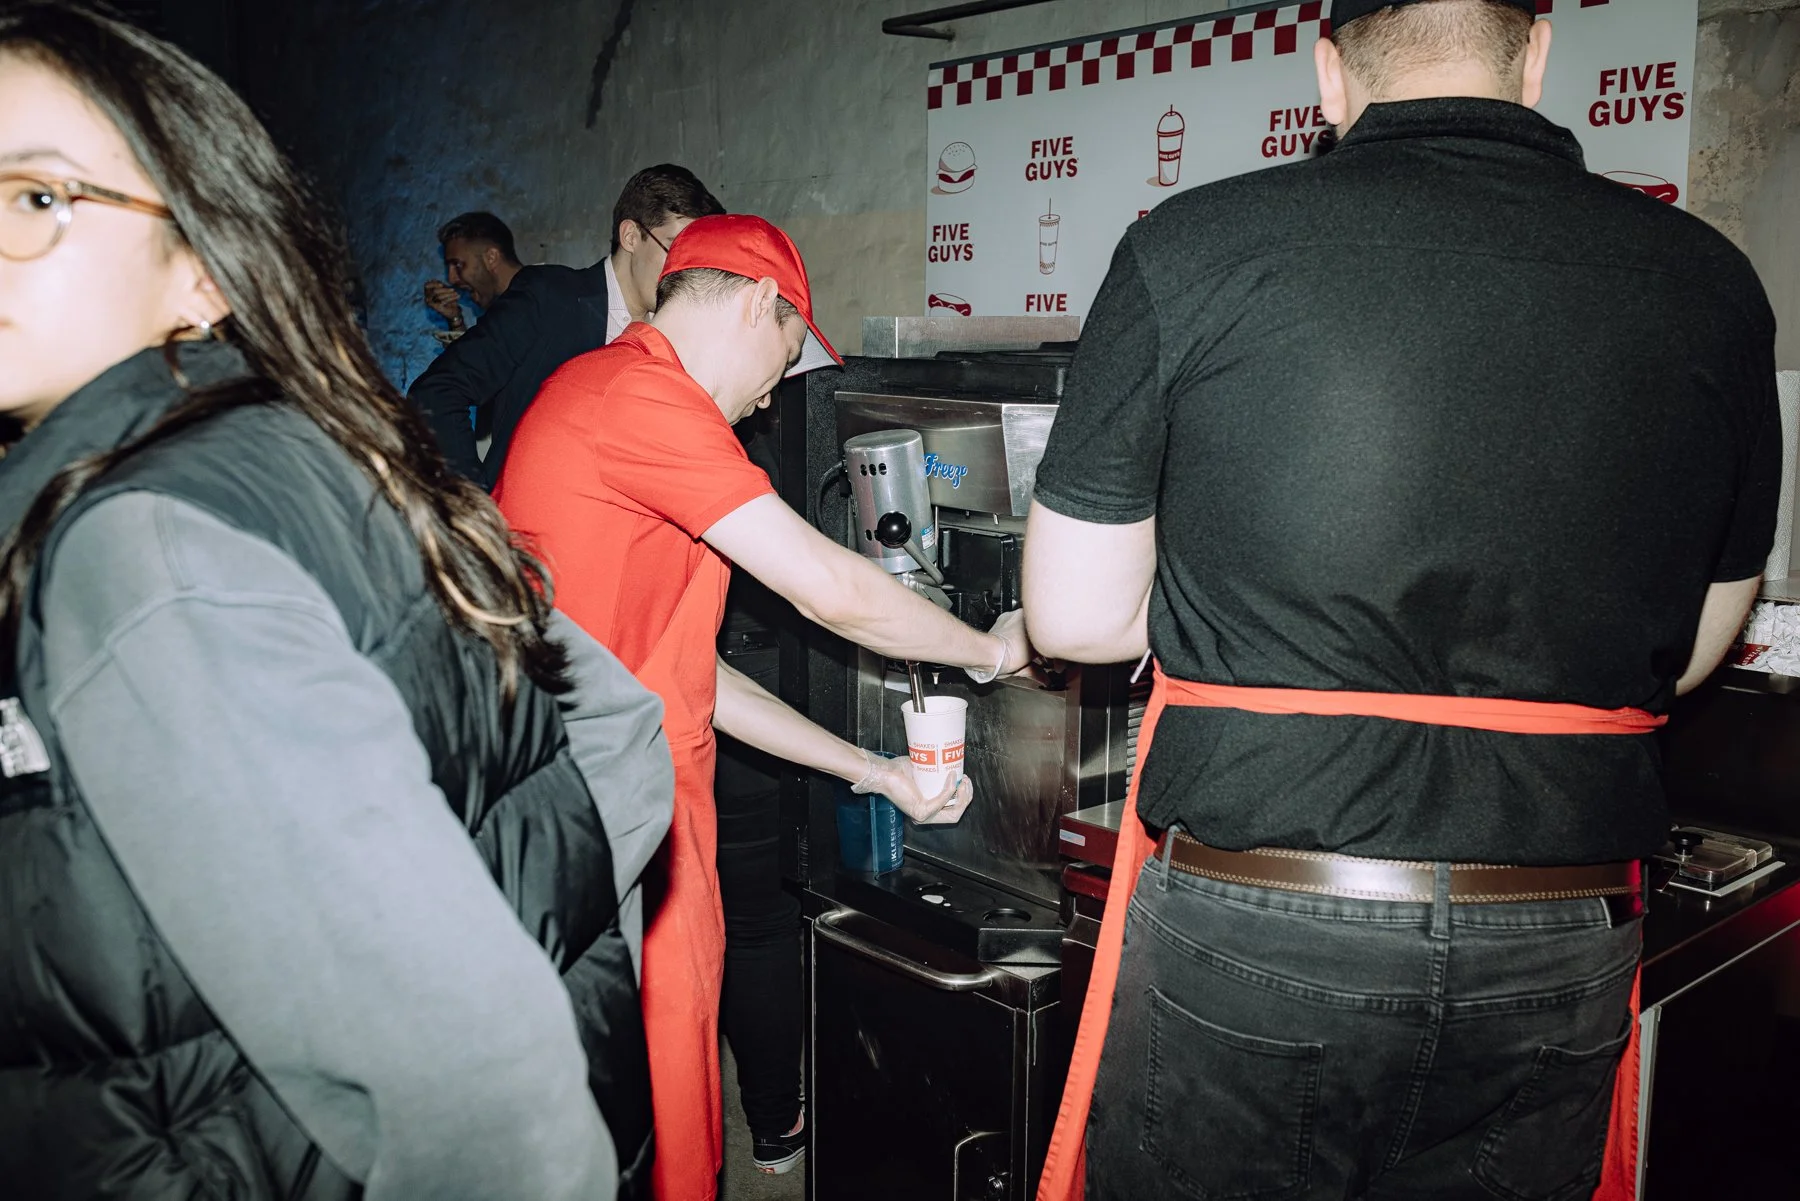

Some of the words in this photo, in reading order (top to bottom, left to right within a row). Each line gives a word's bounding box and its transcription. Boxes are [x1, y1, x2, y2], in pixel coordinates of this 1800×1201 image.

[1600, 61, 1677, 96] FIVE
[1269, 104, 1327, 132] FIVE
[1588, 92, 1685, 127] GUYS
[1031, 136, 1074, 159] FIVE
[1025, 158, 1078, 182] GUYS
[932, 223, 970, 243] FIVE
[928, 243, 974, 263] GUYS
[1025, 293, 1068, 313] FIVE
